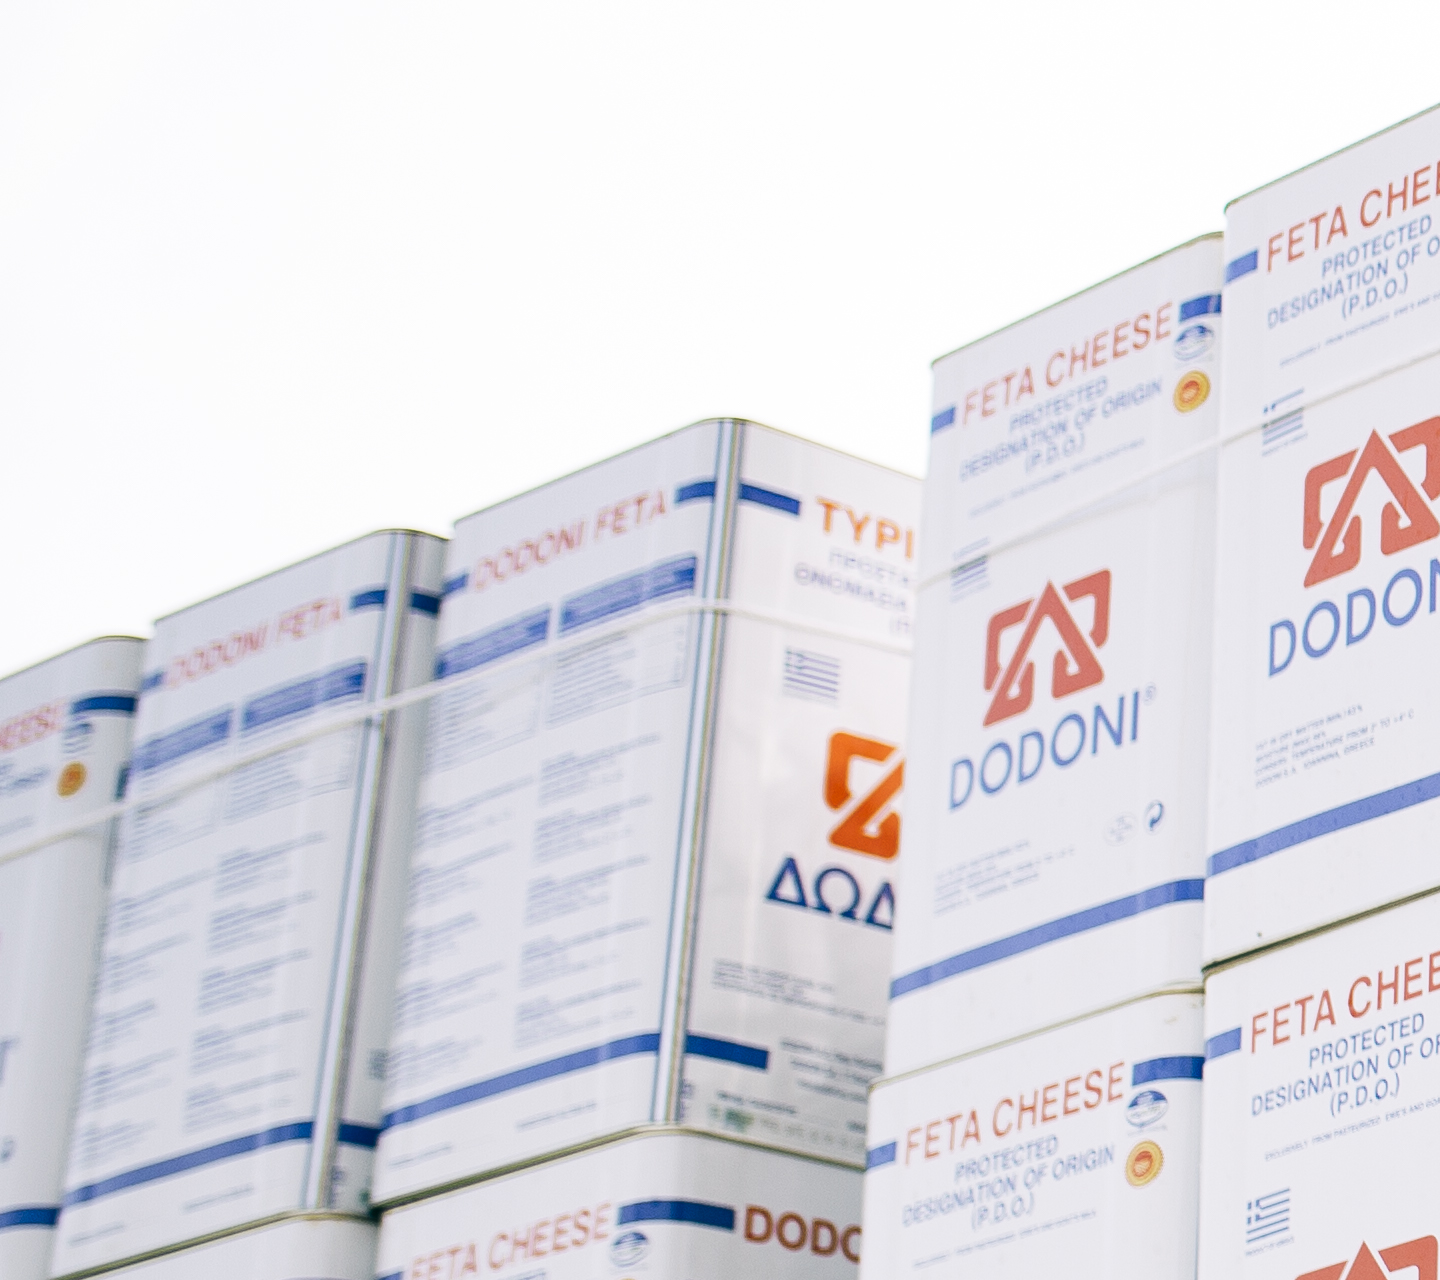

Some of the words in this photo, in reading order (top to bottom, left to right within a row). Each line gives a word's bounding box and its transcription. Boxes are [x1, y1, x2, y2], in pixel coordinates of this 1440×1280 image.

[1267, 205, 1348, 272] FETA
[963, 365, 1035, 425] FETA
[1045, 301, 1172, 390] CHEESE
[1251, 989, 1336, 1053] FETA
[906, 1109, 981, 1164] FETA
[992, 1061, 1125, 1139] CHEESE
[488, 1202, 610, 1272] CHEESE
